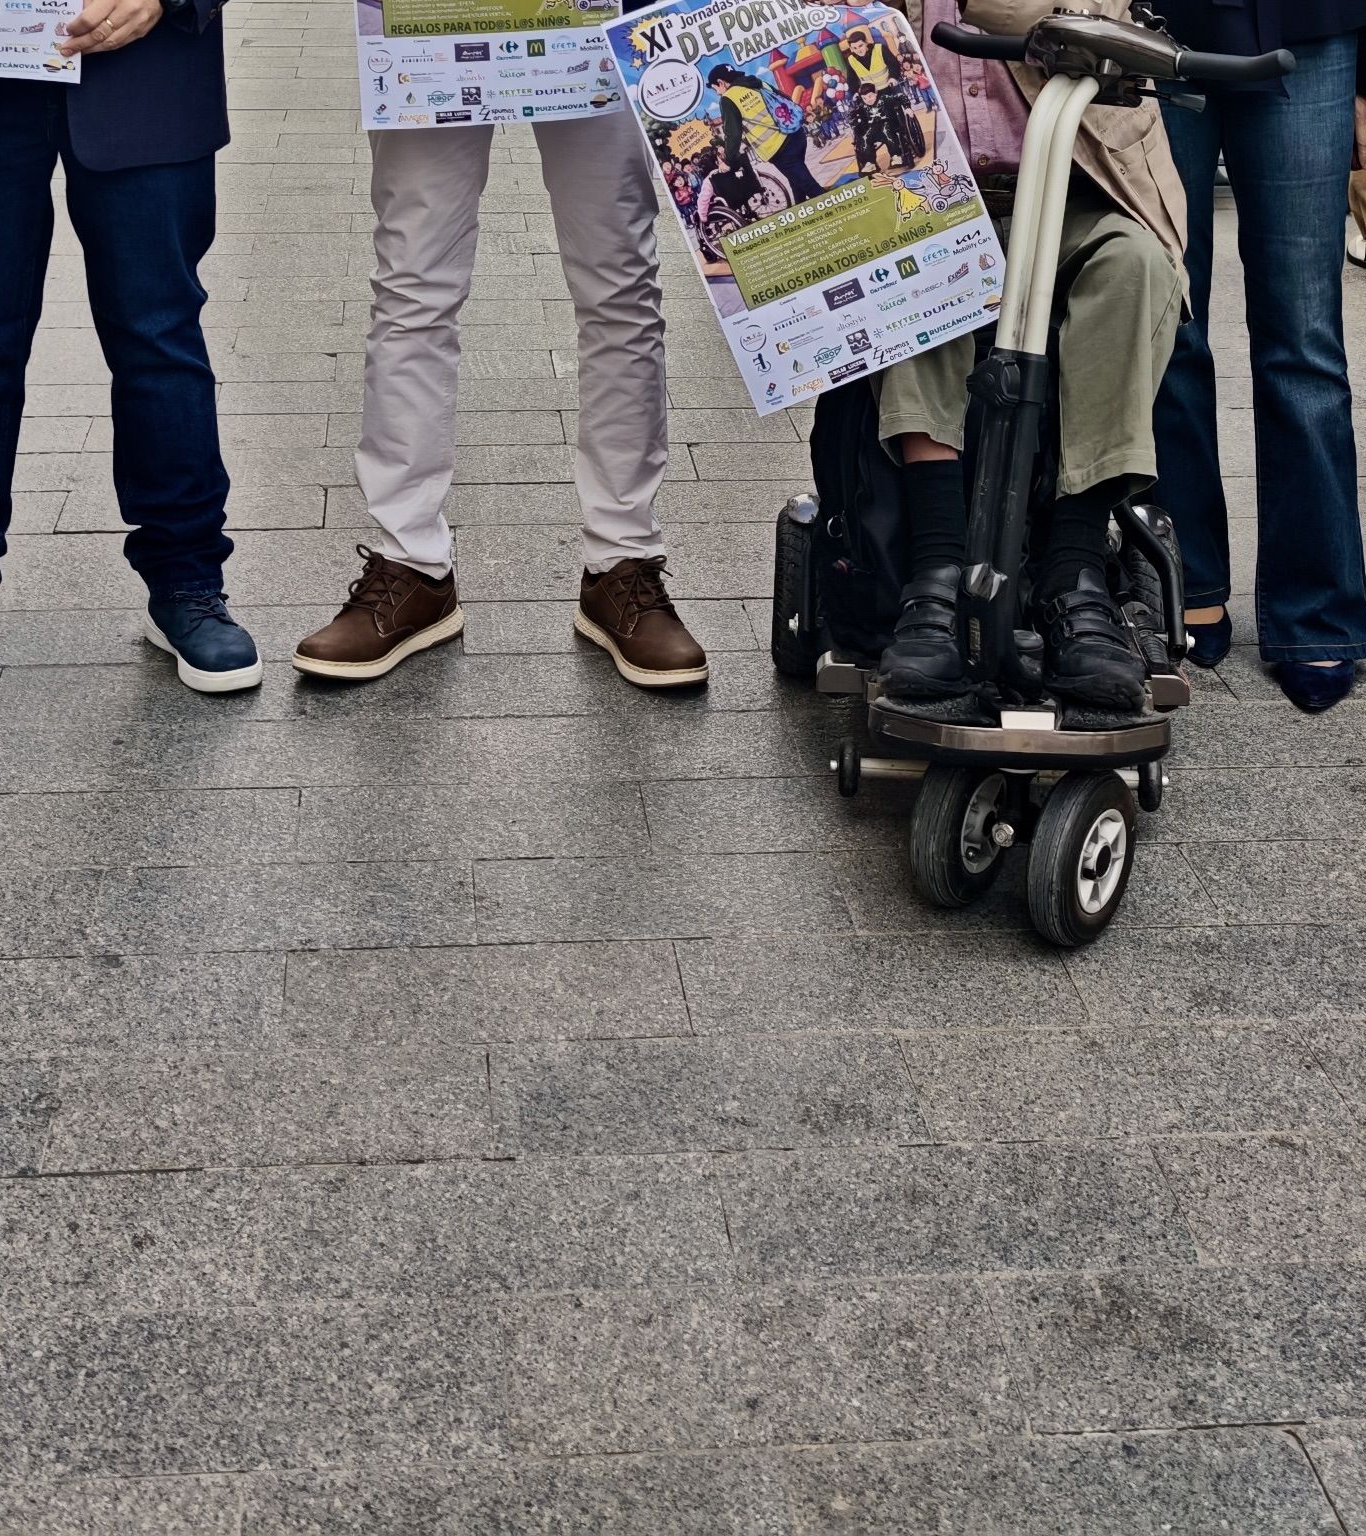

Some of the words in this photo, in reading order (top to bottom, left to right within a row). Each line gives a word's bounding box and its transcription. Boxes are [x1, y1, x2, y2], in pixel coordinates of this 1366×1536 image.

[391, 23, 441, 35] REGALOS
[444, 22, 472, 33] PARA
[474, 19, 511, 31] TOD@S
[514, 18, 534, 29] L@S
[537, 15, 571, 27] NIÑ@S
[731, 30, 778, 61] PARA
[777, 7, 837, 41] NIÑ@S
[535, 86, 586, 95] DUPLEX
[535, 102, 588, 112] RUIZCÁNOVAS
[726, 218, 777, 248] Viernes
[776, 210, 796, 227] 30
[796, 203, 815, 219] de
[814, 181, 867, 212] octubre
[731, 235, 770, 256] Recapacita
[784, 223, 801, 234] Plaza
[801, 214, 824, 227] Nueva
[823, 209, 834, 218] de
[834, 203, 847, 213] 17h
[853, 197, 862, 205] 20
[921, 247, 949, 263] EFETA
[952, 241, 977, 256] Mobility
[976, 235, 991, 245] Cars
[750, 275, 804, 305] REGALOS
[803, 262, 834, 283] PARA
[833, 245, 875, 271] TOD@S
[873, 235, 897, 254] L@S
[896, 219, 934, 245] NIÑ@S
[922, 291, 976, 318] DUPLEX
[885, 311, 921, 330] KEYTER
[928, 308, 983, 335] RUIZCÁNOVAS
